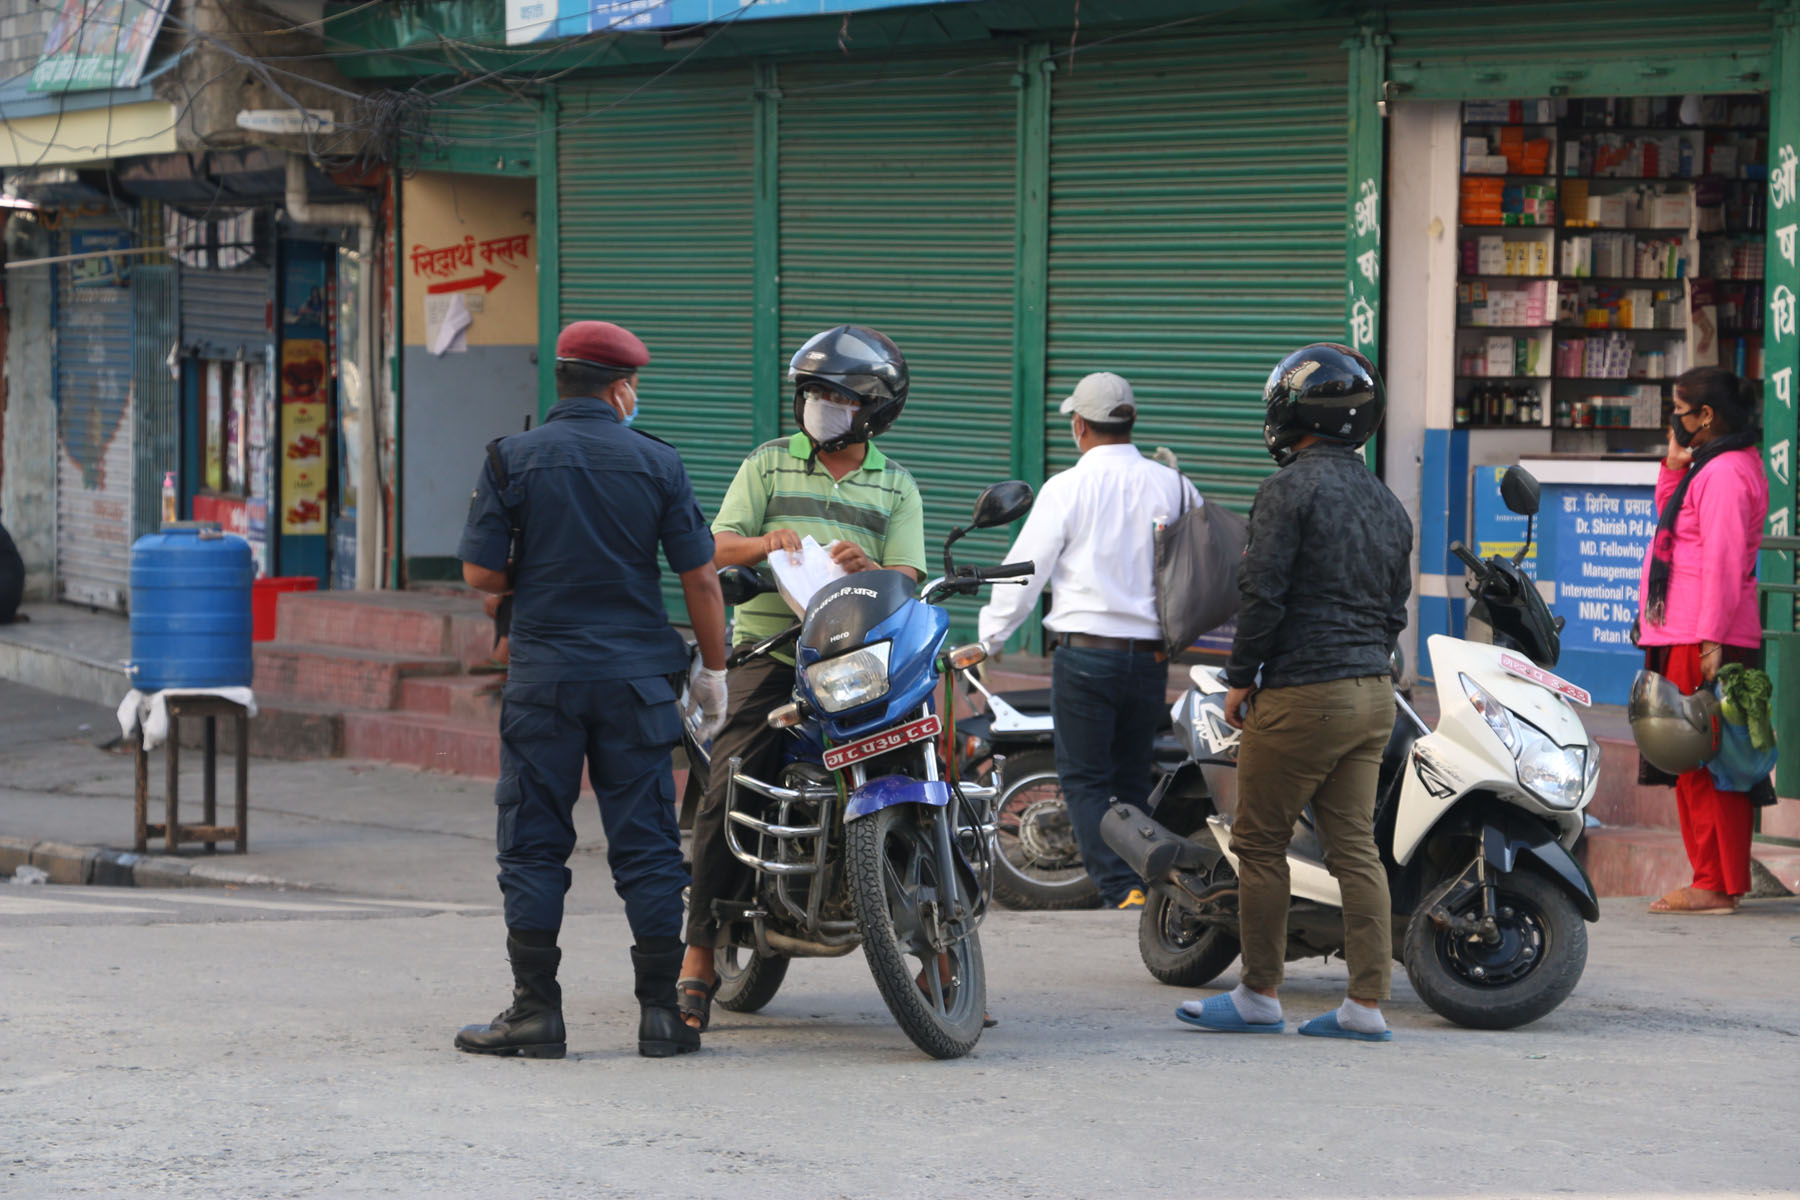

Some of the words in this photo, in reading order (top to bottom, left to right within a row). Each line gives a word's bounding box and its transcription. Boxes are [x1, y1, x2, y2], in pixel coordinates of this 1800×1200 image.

[1576, 517, 1590, 534] Dr.
[1592, 518, 1627, 536] Shirish
[1629, 520, 1644, 537] Pd
[1580, 541, 1598, 556] MD.
[1600, 541, 1644, 562] Fellowhip
[1582, 562, 1642, 582] Management
[1562, 582, 1624, 600] Interventional
[1579, 602, 1610, 621] NMC
[1593, 627, 1620, 643] Patan
